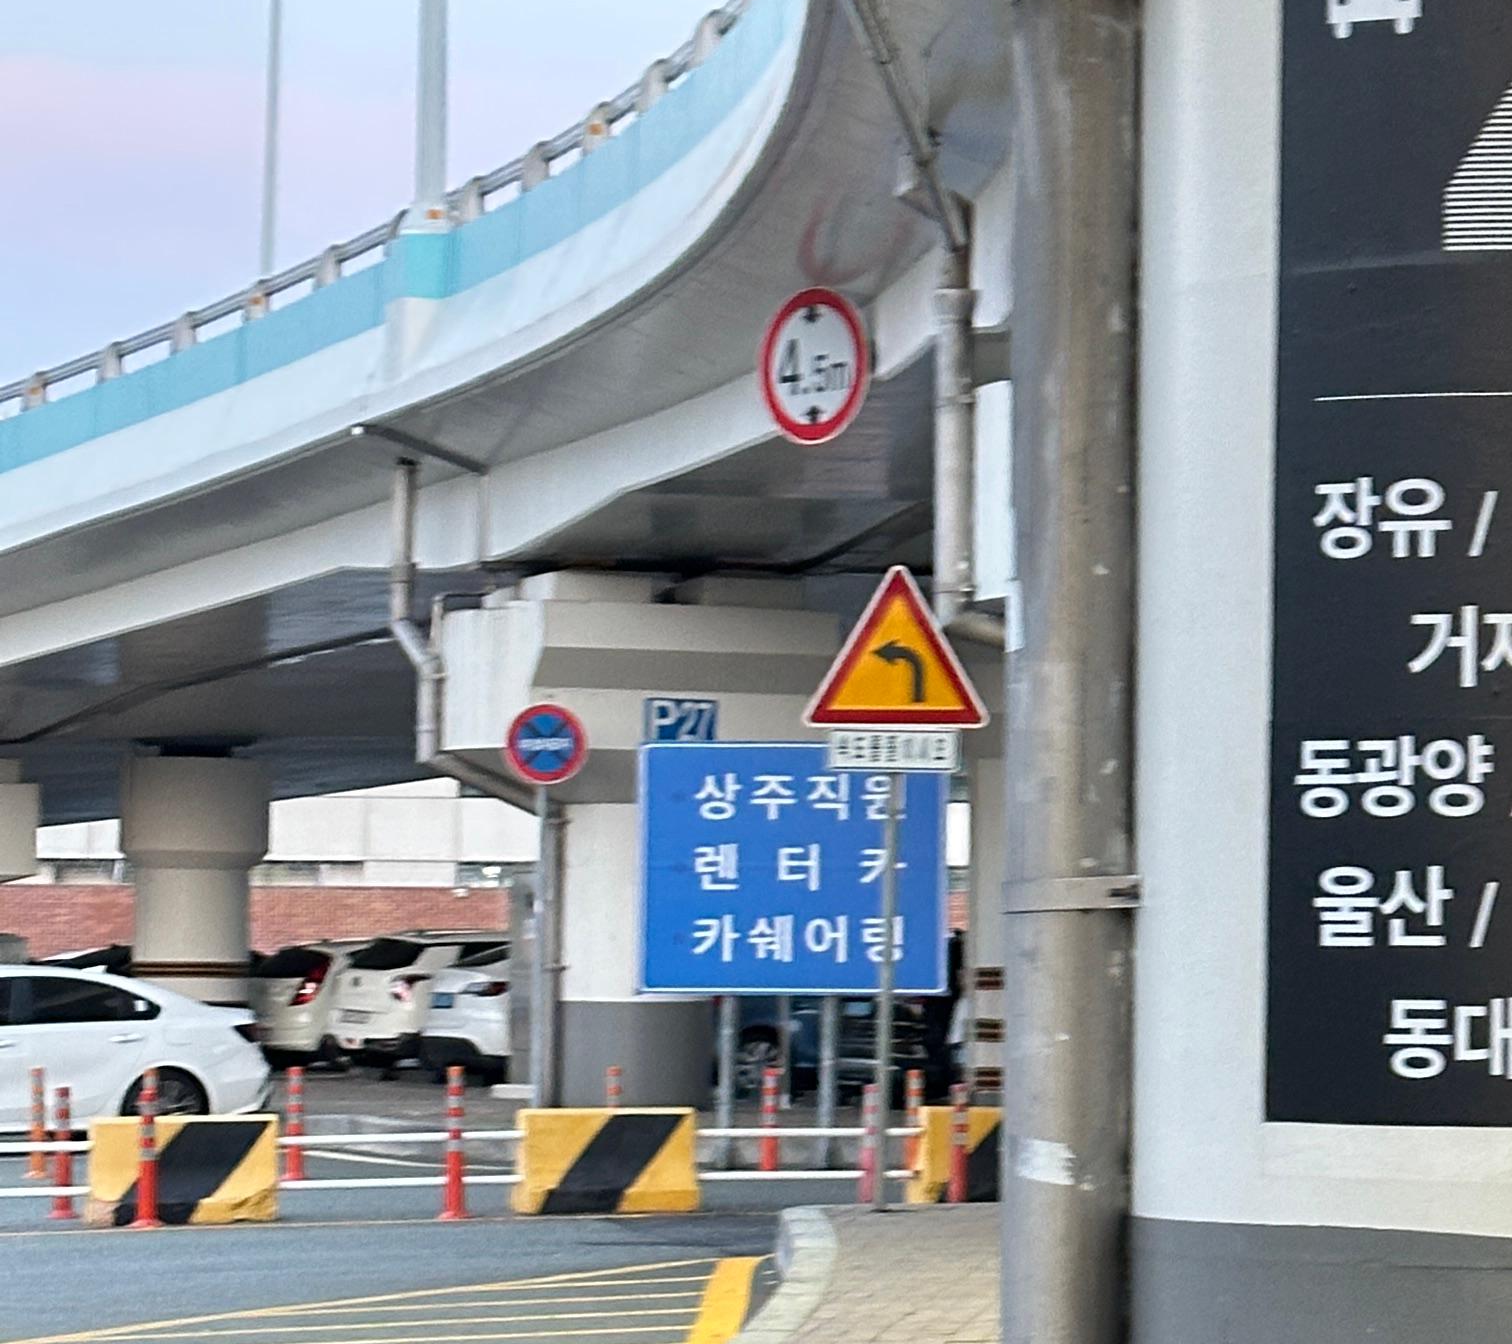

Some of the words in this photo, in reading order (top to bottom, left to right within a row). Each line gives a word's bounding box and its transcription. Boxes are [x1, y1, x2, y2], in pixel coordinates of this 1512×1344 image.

[1314, 477, 1452, 559] 장유
[1469, 491, 1497, 556] /
[653, 700, 715, 740] P27
[694, 773, 907, 821] 상주직원
[1295, 735, 1493, 817] 동광양
[1313, 866, 1453, 946] 울산
[1470, 882, 1498, 947] /
